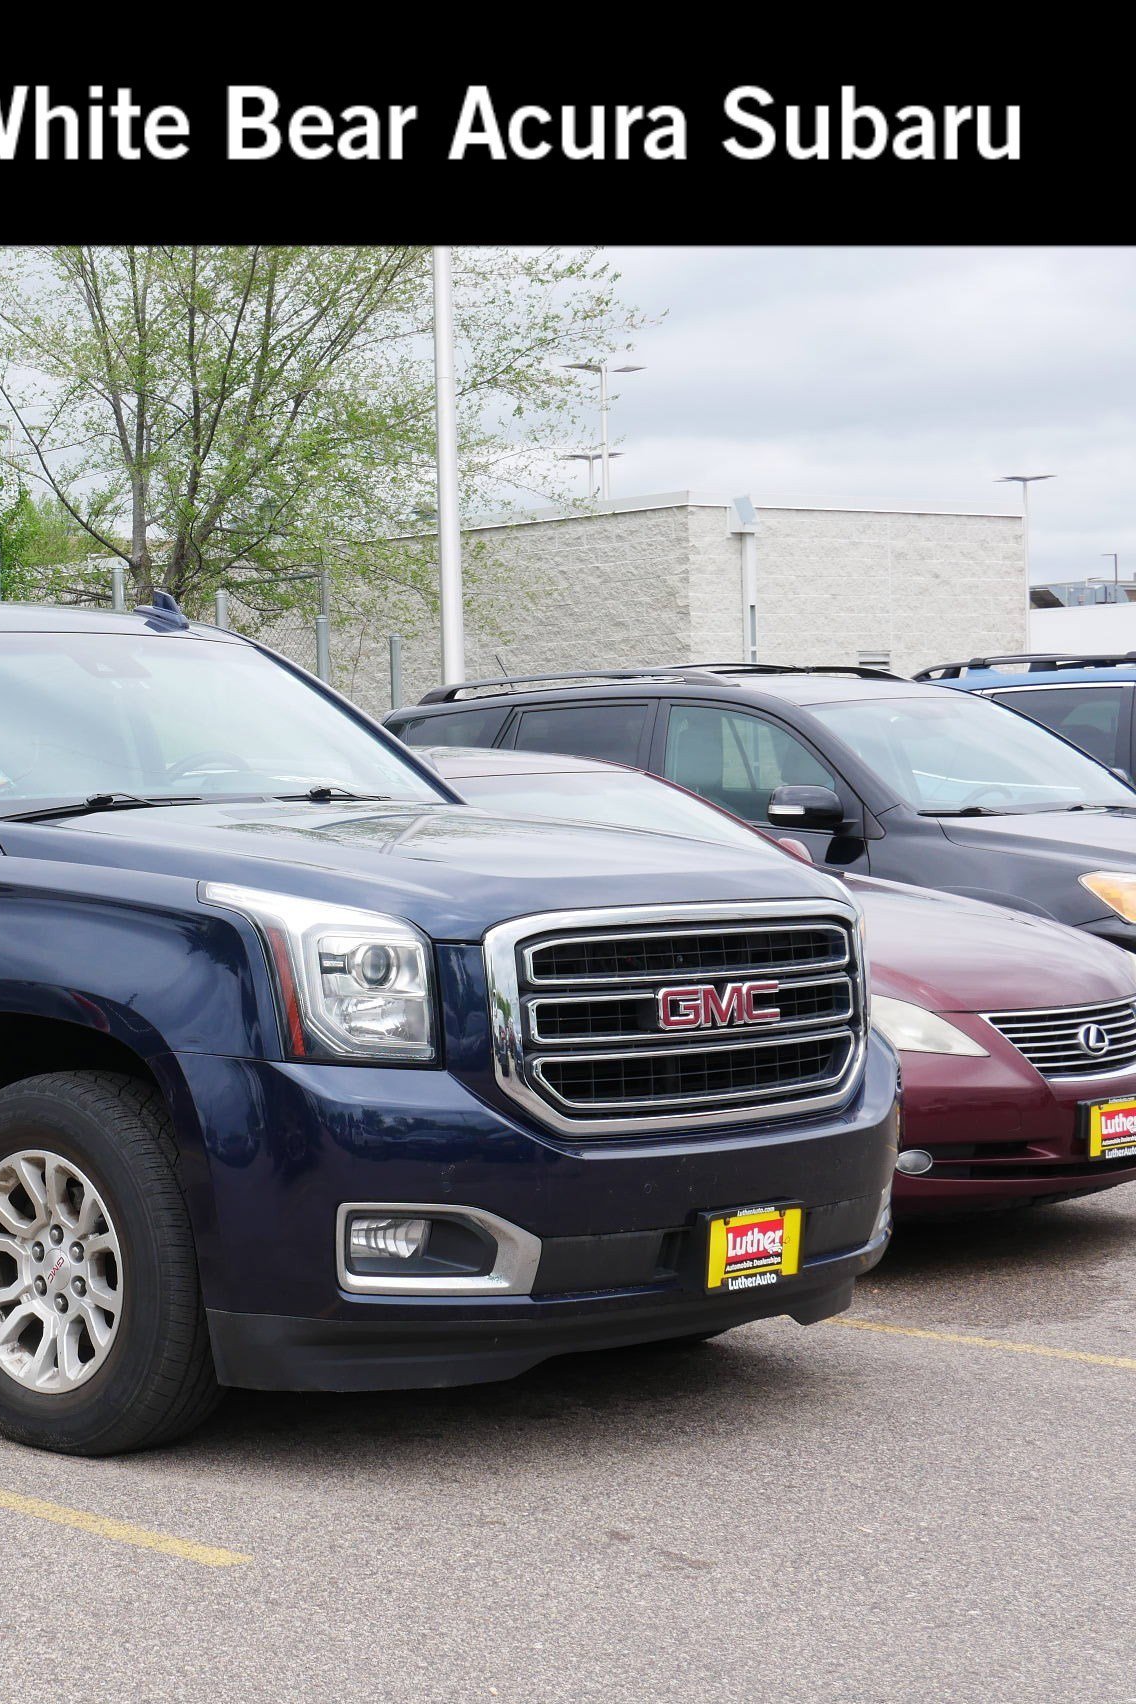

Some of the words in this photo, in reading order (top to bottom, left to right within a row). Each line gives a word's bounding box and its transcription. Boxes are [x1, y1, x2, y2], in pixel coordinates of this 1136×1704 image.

[658, 980, 781, 1031] GMC
[727, 1227, 783, 1258] Luther
[47, 1256, 65, 1284] GMC
[725, 1260, 753, 1272] Automobile
[728, 1272, 777, 1290] LutherAuto
